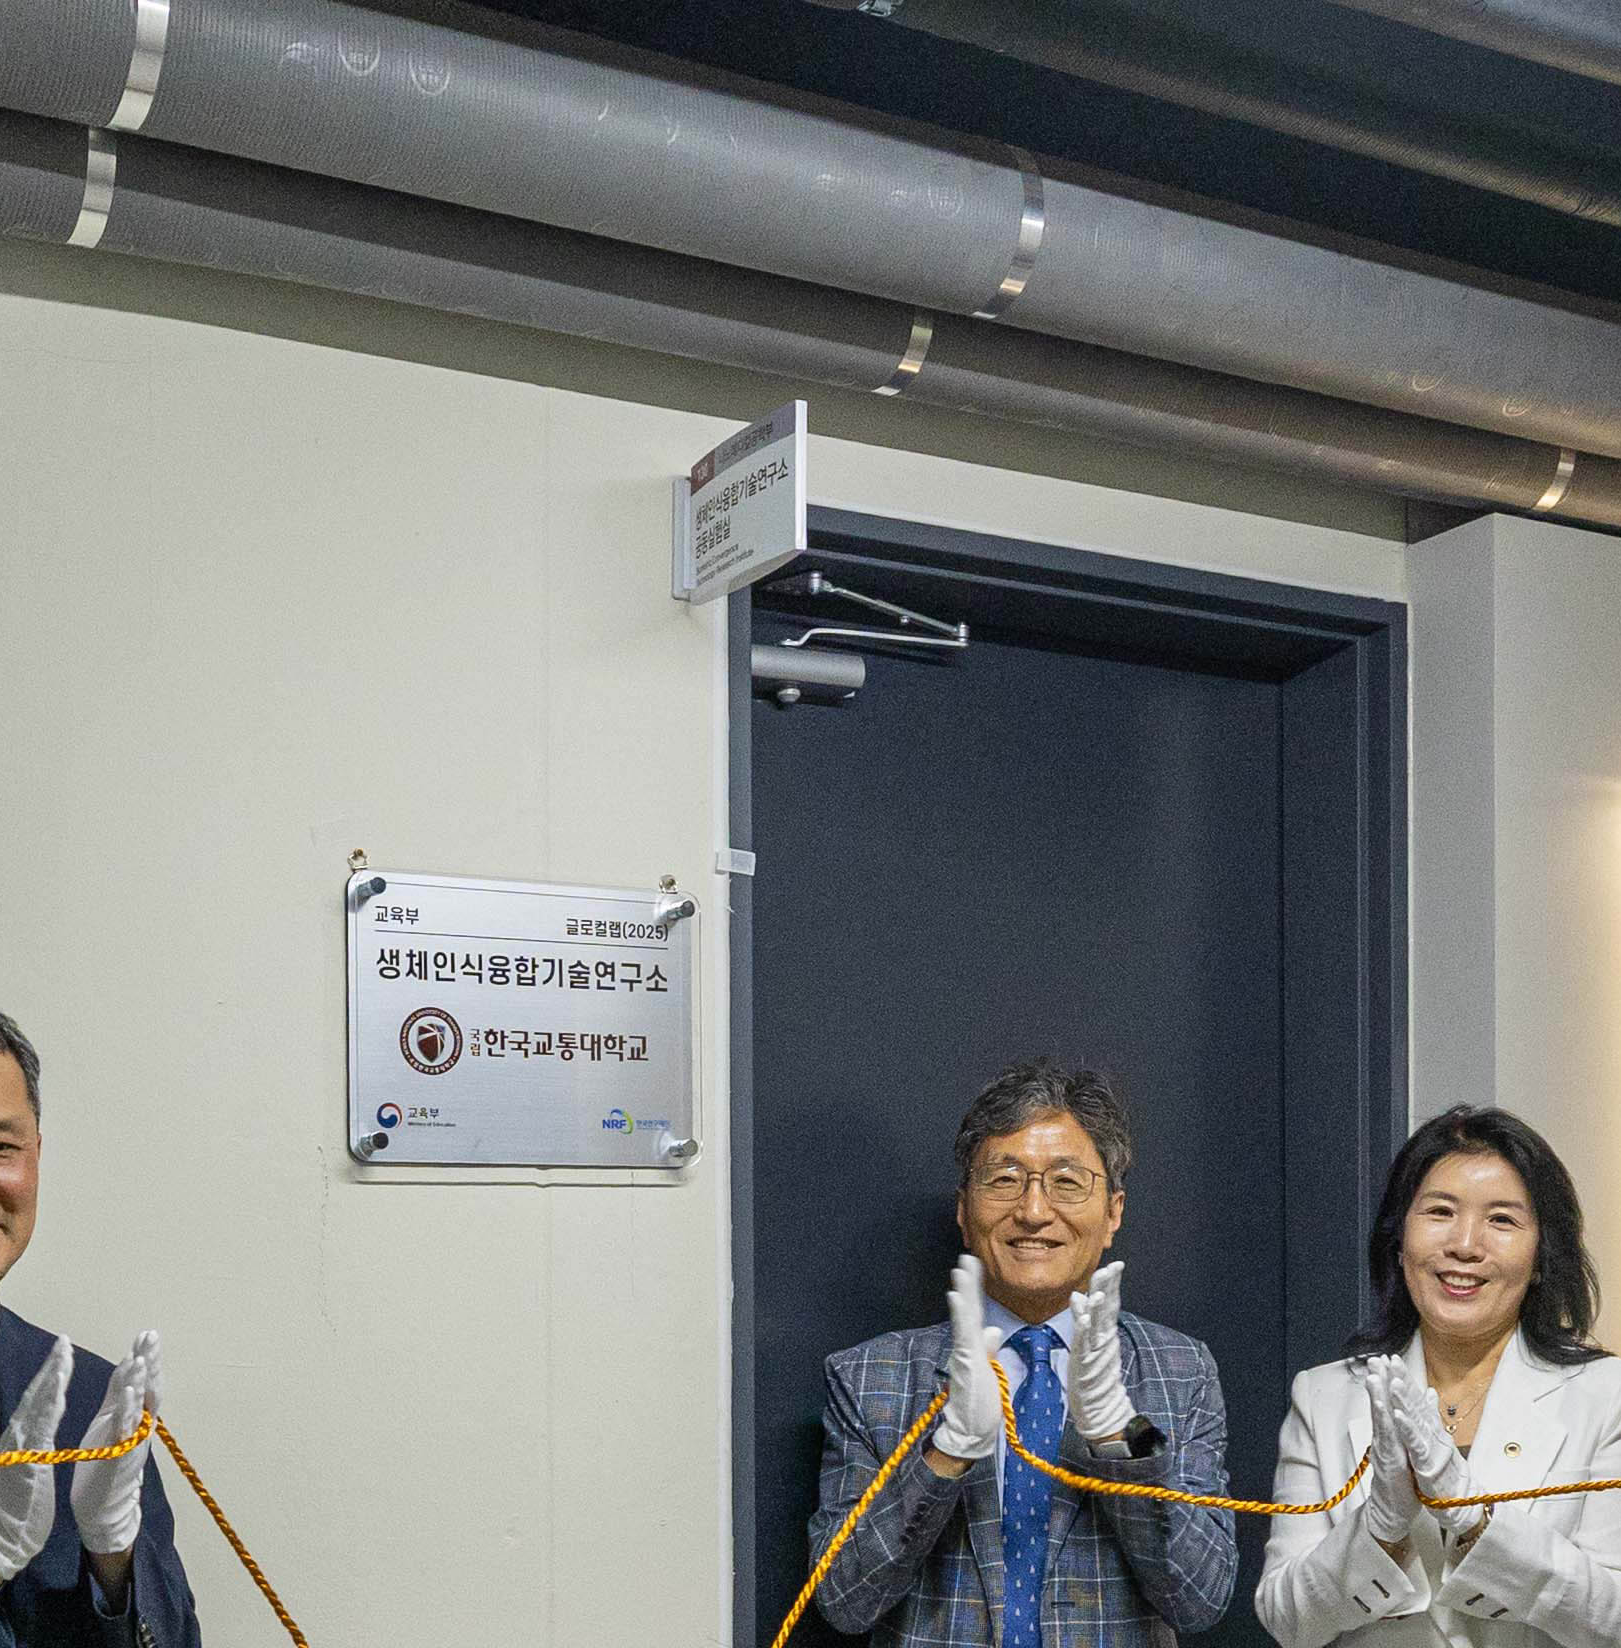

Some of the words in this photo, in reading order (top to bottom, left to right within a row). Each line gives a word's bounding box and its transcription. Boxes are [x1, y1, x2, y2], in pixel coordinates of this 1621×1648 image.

[695, 457, 789, 532] 생체인식융합기술연구소
[374, 905, 420, 926] 교육부
[566, 917, 669, 942] 글로컬랩(2025)
[376, 949, 669, 993] 생체인식융합기술연구소
[484, 1028, 649, 1062] 한국교통대학교
[407, 1107, 439, 1119] 교육부
[602, 1119, 627, 1129] NRF
